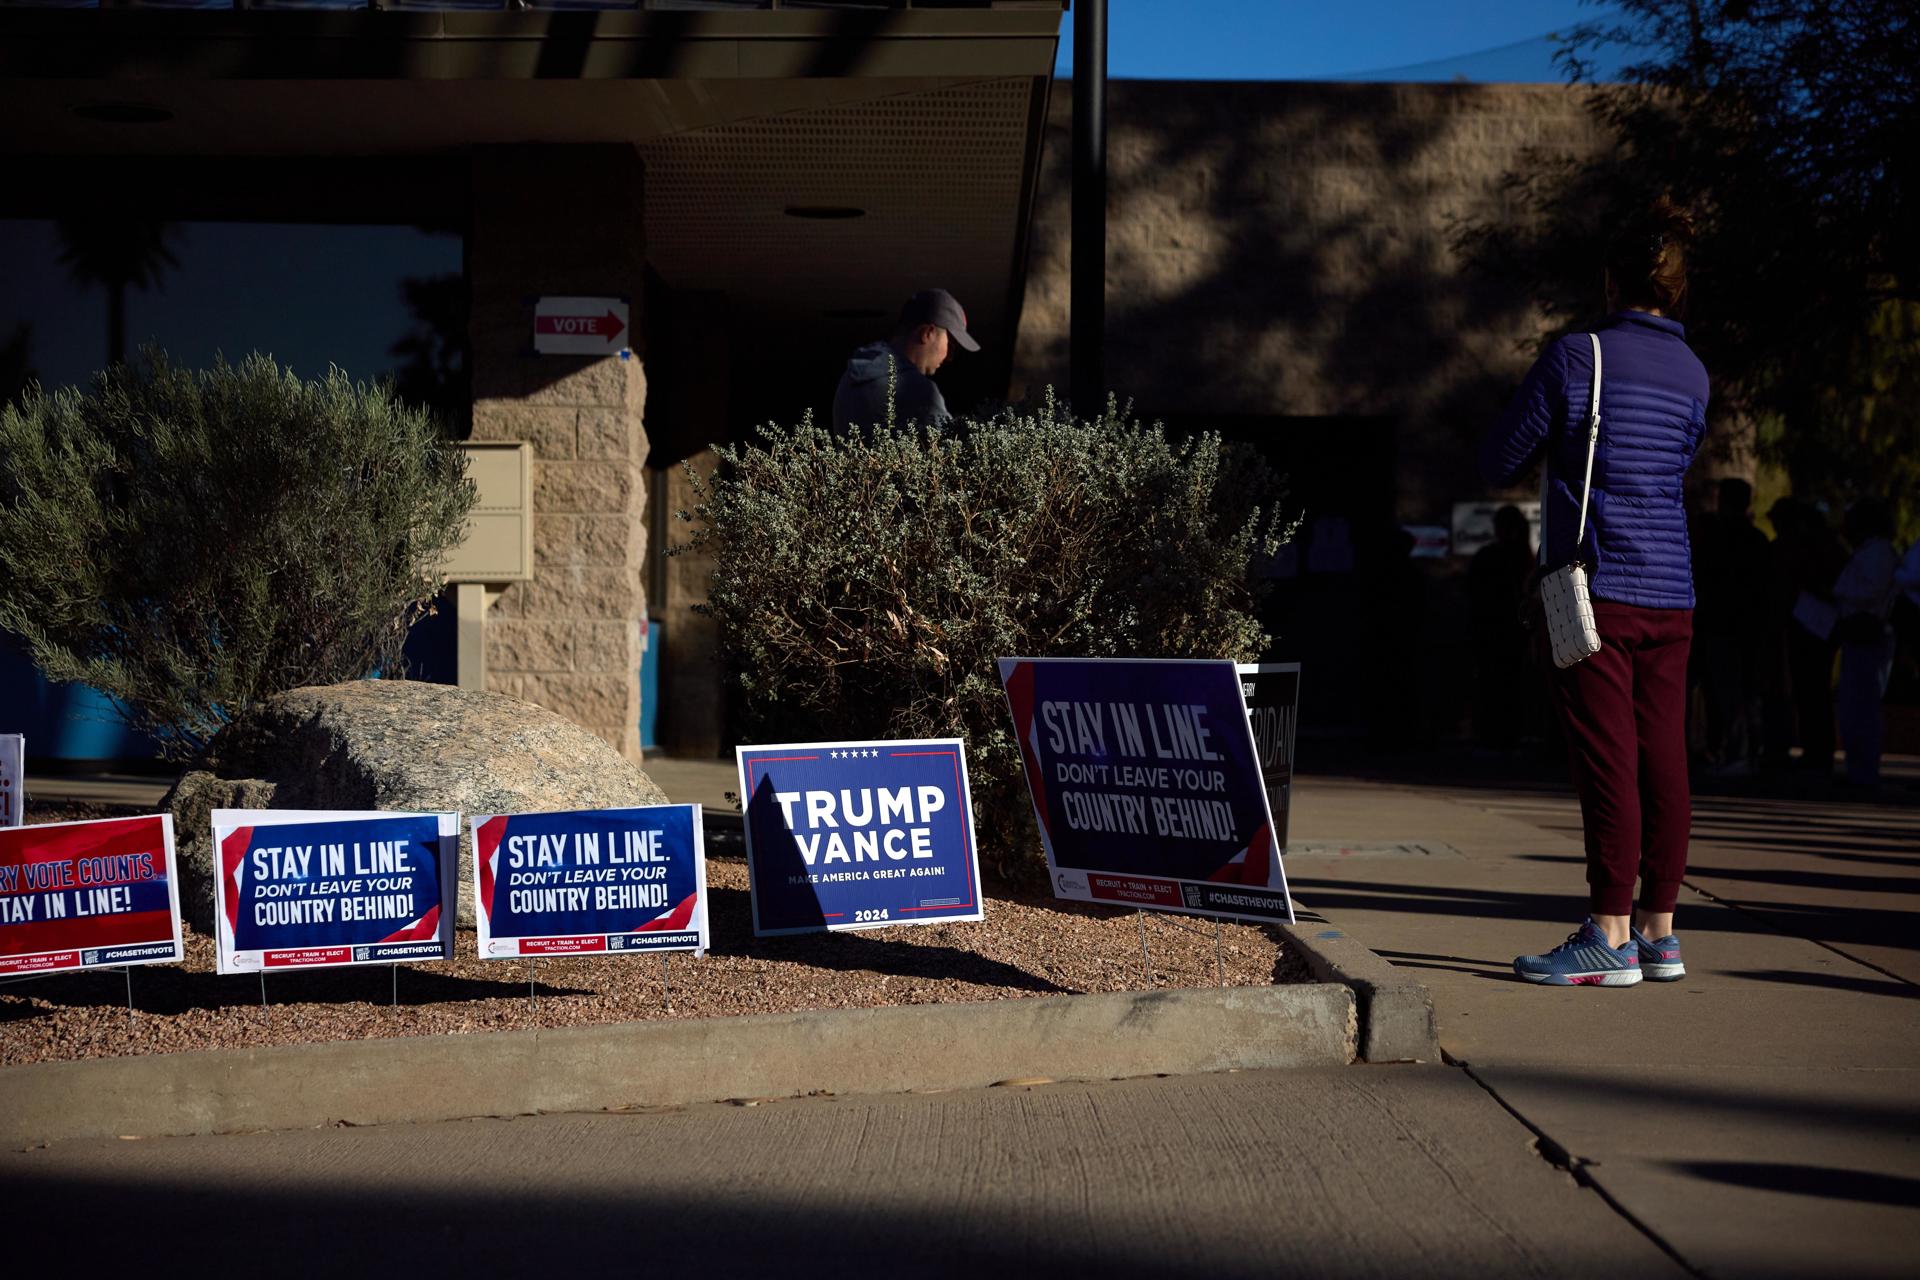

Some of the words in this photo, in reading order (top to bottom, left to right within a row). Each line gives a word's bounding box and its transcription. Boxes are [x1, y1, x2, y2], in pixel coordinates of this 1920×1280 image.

[553, 318, 598, 333] VOTE
[1042, 700, 1108, 756] STAY
[1110, 702, 1146, 758] IN
[1146, 702, 1225, 761] LINE.
[1247, 705, 1295, 769] RIDAN
[1056, 762, 1109, 785] DON'T
[1114, 765, 1170, 789] LEAVE
[1172, 768, 1226, 792] YOUR
[771, 785, 946, 830] TRUMP
[1062, 790, 1150, 835] COUNTRY
[1150, 796, 1239, 843] BEHIND!
[508, 834, 567, 868] STAY
[575, 832, 600, 865] IN
[608, 829, 671, 864] LINE.
[794, 827, 934, 866] VANCE
[253, 845, 312, 881] STAY
[320, 843, 346, 877] IN
[354, 840, 417, 875] LINE.
[23, 860, 74, 889] VOTE
[509, 871, 561, 886] DON'T
[564, 868, 616, 884] LEAVE
[621, 866, 667, 881] YOUR
[788, 874, 819, 885] MAKE
[822, 871, 870, 883] AMERICA
[873, 868, 906, 880] GREAT
[909, 866, 945, 878] AGAIN!
[254, 882, 306, 898] DON'T
[310, 880, 361, 896] LEAVE
[367, 877, 412, 891] YOUR
[1096, 878, 1121, 888] RECRUIT
[1128, 881, 1147, 891] TRAIN
[1153, 884, 1172, 893] ELECT
[0, 894, 35, 923] TAY
[44, 892, 66, 919] IN
[75, 886, 132, 917] LINE!
[509, 886, 590, 914] COUNTRY
[594, 883, 668, 911] BEHIND!
[1187, 894, 1203, 907] VOTE
[1209, 892, 1286, 910] #CHASETHEVOTE
[254, 898, 335, 927] COUNTRY
[340, 893, 415, 922] BEHIND!
[855, 908, 889, 922] 2024
[611, 941, 624, 950] VOTE
[631, 935, 698, 945] #CHASETHEVOTE
[85, 956, 99, 965] VOTE
[105, 945, 174, 959] #CHASETHEVOTE
[356, 952, 370, 961] VOTE
